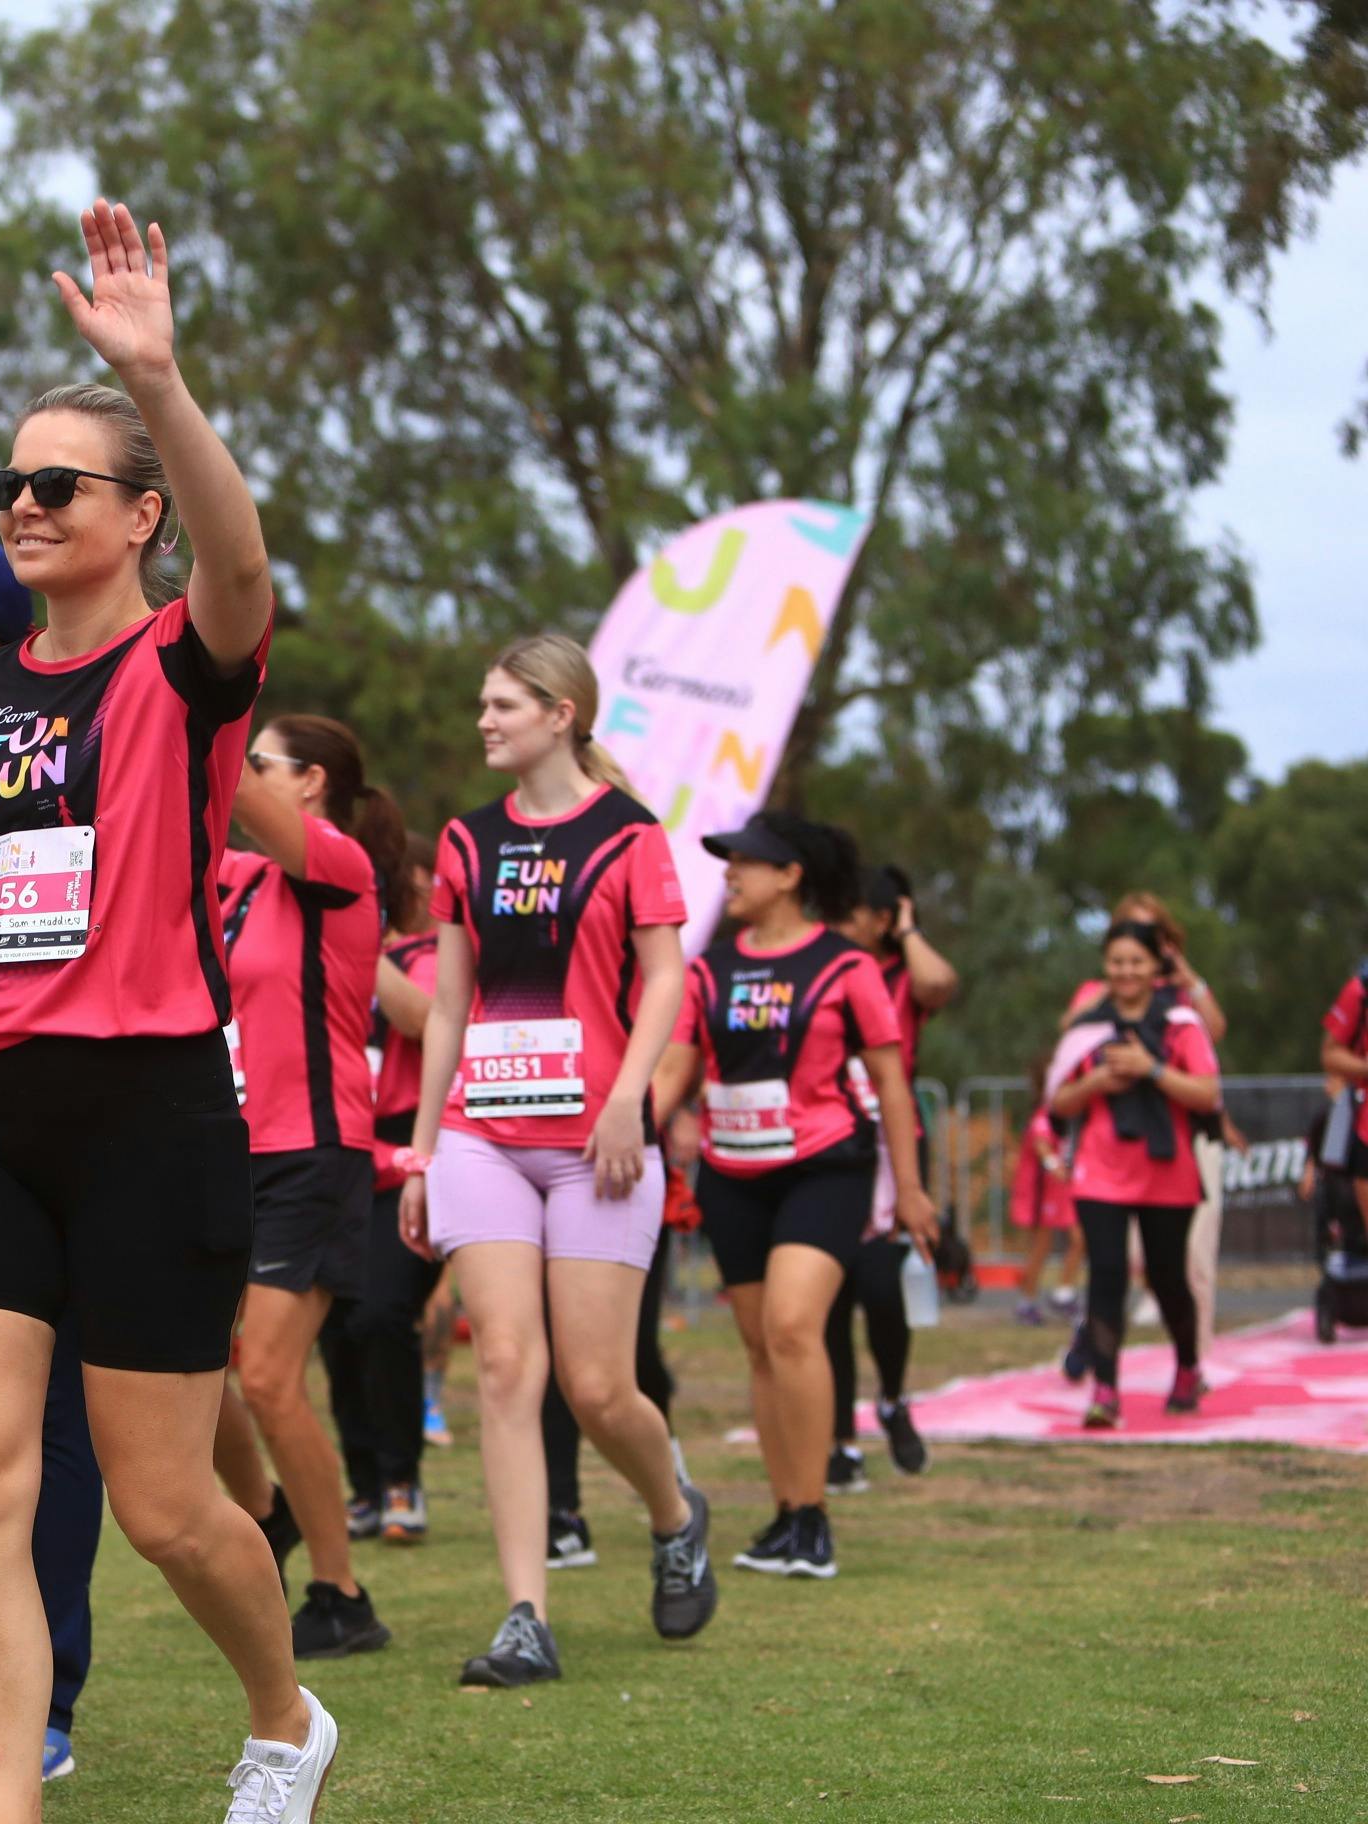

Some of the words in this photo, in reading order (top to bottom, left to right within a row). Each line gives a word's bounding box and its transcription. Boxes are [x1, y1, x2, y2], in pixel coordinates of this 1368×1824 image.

[74, 871, 82, 890] Pink
[497, 859, 567, 886] FUN
[65, 881, 74, 901] Walk
[493, 886, 561, 915] RUN
[9, 918, 29, 928] Sam
[40, 914, 74, 926] Maddie
[730, 982, 794, 1006] FUN
[727, 1006, 791, 1032] RUN
[470, 1056, 542, 1081] 10551
